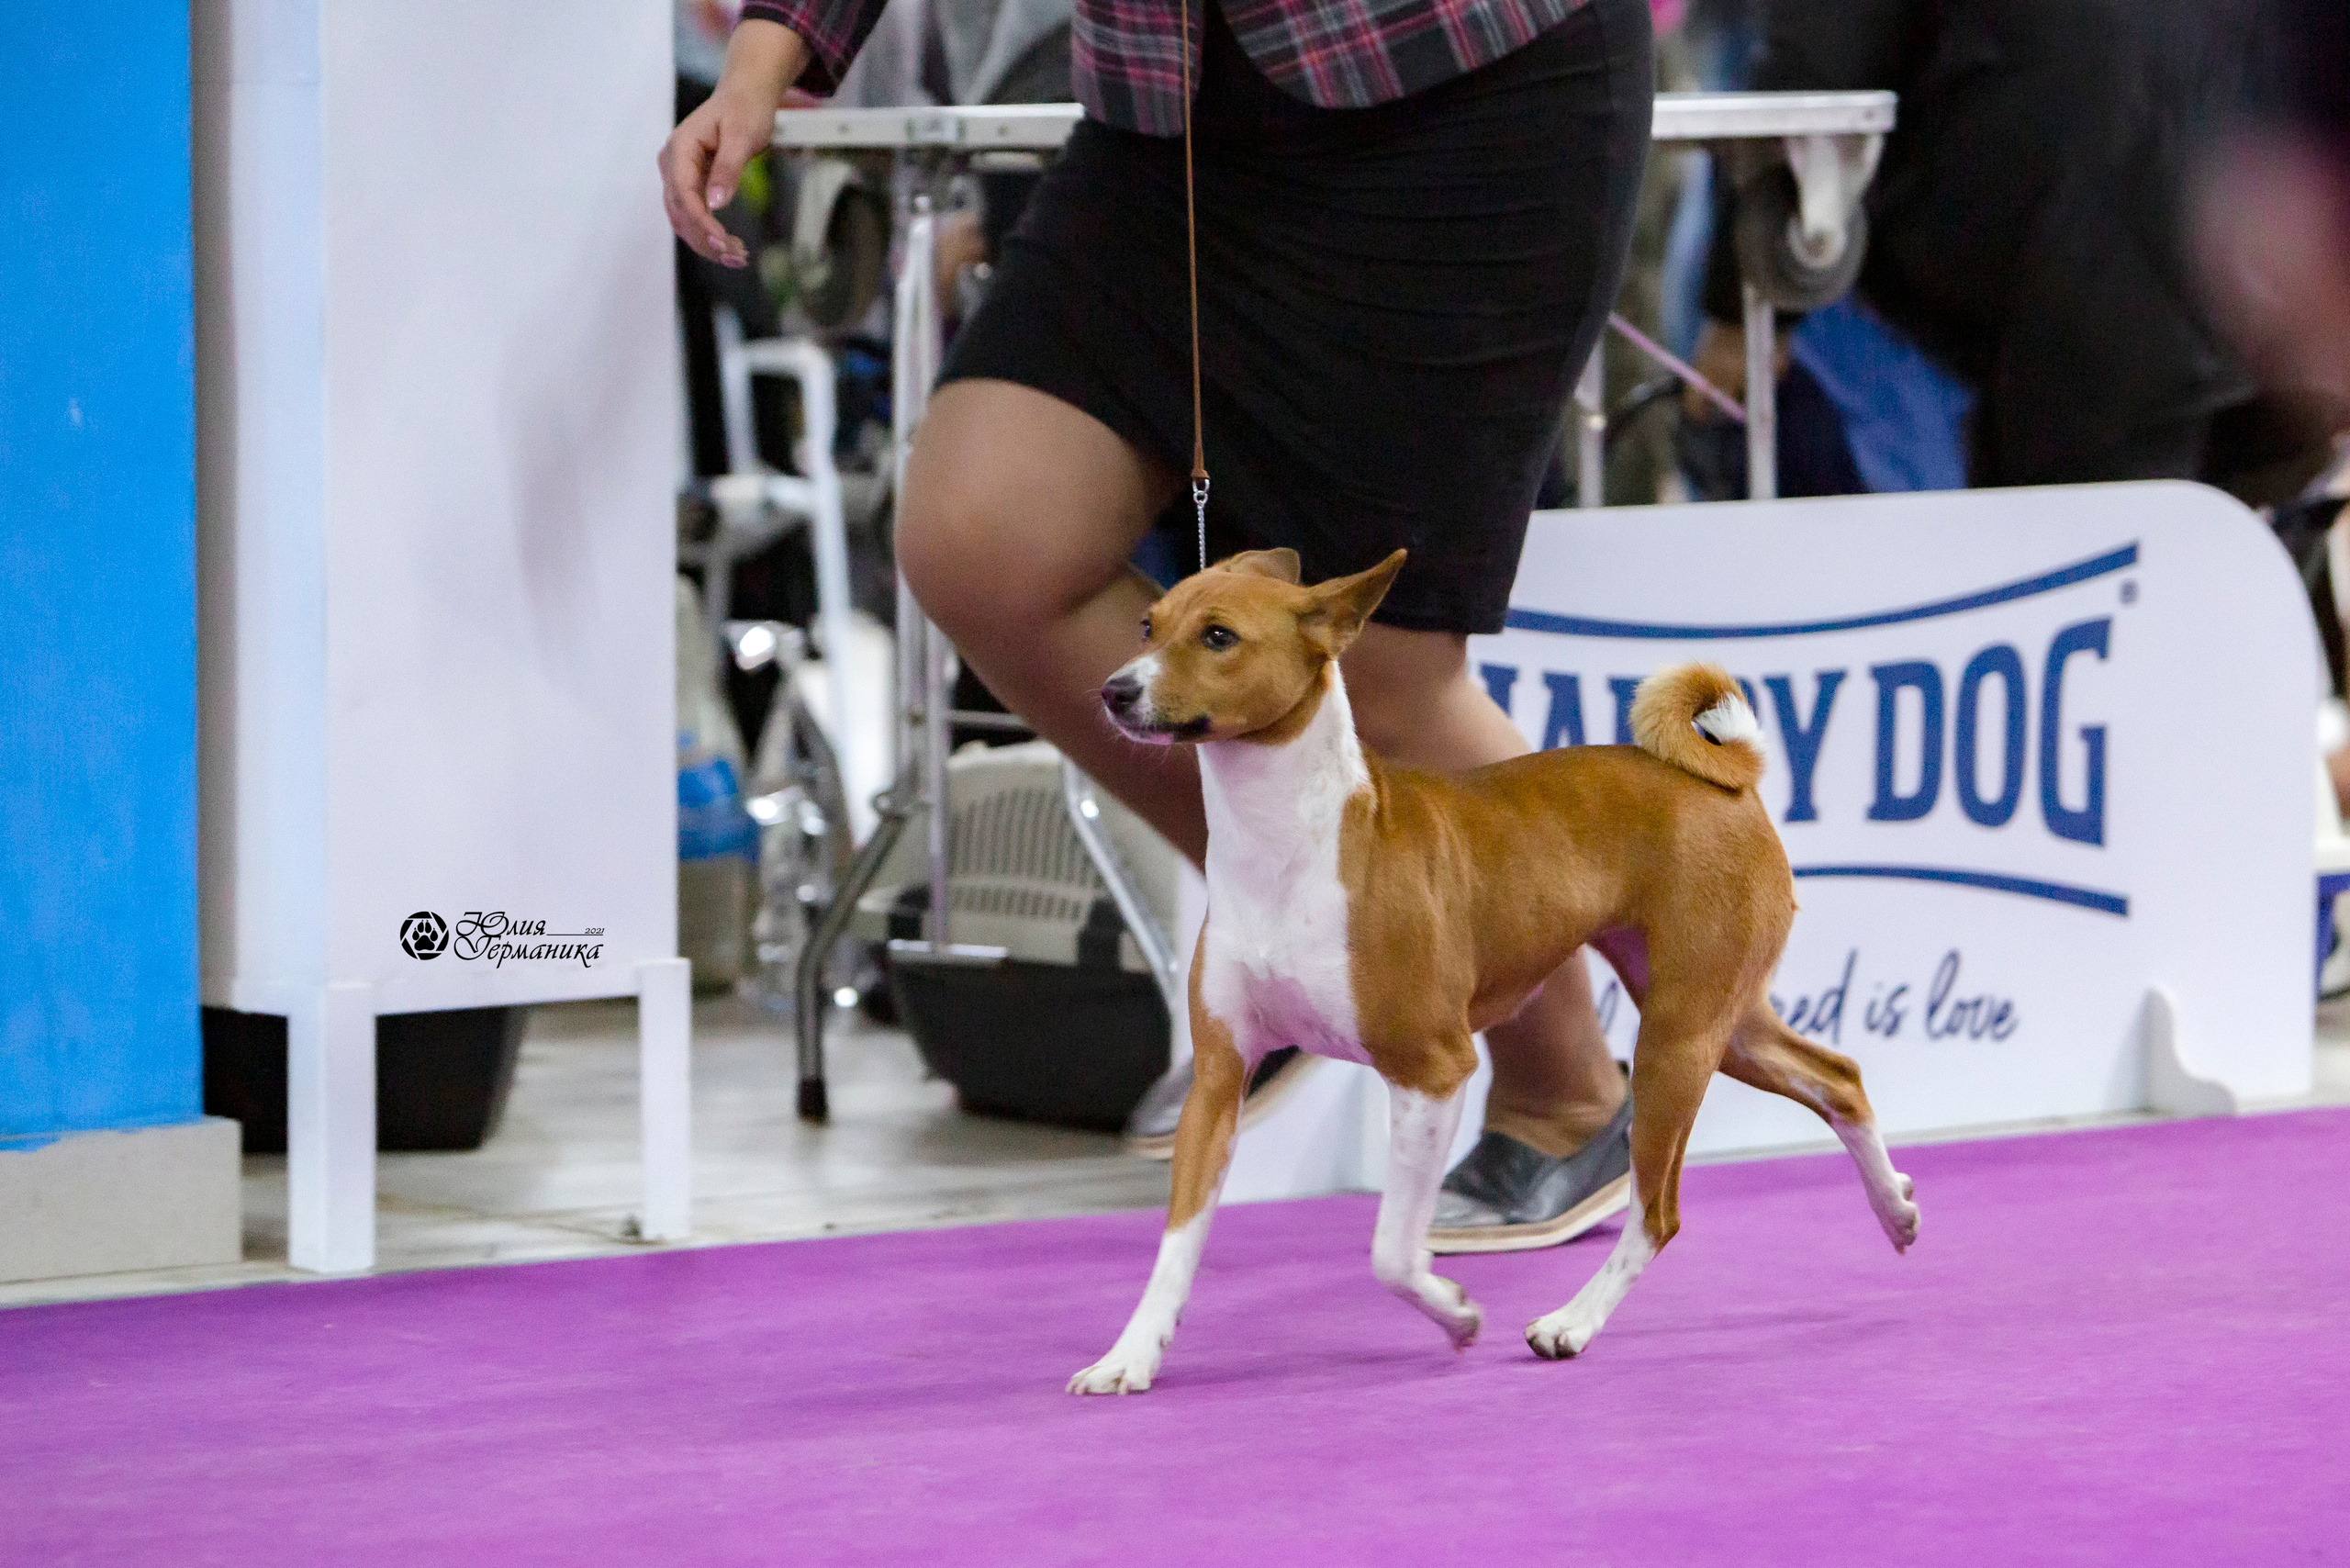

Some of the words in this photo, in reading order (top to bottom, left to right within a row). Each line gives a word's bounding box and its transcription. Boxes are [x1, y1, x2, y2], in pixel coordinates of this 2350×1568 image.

[1865, 613, 2113, 847] DOG
[1863, 980, 1908, 1038] is
[1927, 947, 2019, 1041] love
